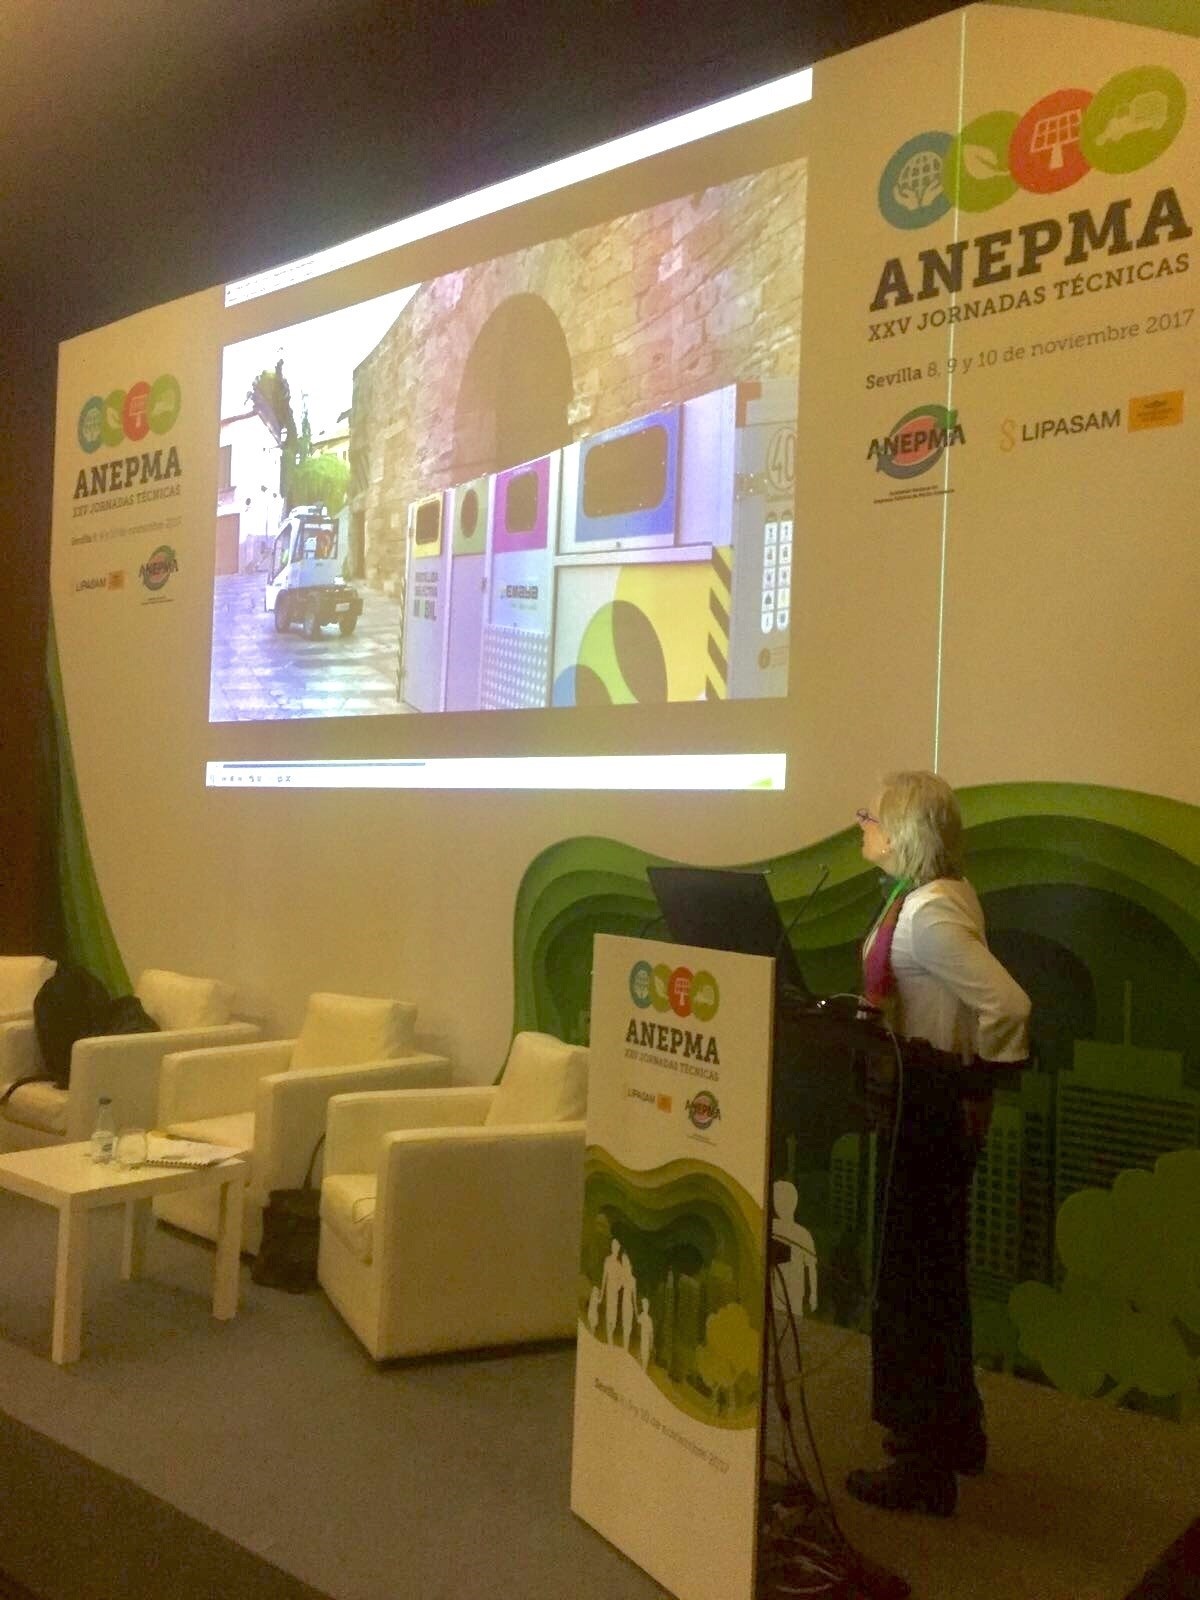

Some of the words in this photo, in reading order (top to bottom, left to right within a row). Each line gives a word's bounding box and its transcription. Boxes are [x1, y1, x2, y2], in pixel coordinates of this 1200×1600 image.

[869, 186, 1193, 312] ANEPMA
[867, 317, 911, 342] XXV
[916, 286, 1046, 332] JORNADAS
[1053, 252, 1190, 300] TÉCNICAS
[865, 367, 922, 390] Sevilla
[946, 358, 957, 374] 9
[962, 357, 973, 374] y
[977, 350, 997, 368] 10
[1003, 345, 1025, 363] de
[1031, 321, 1140, 357] noviembre
[1145, 308, 1195, 334] 2017
[866, 423, 966, 461] ANEPMA
[1022, 409, 1121, 442] LIPASAM
[73, 445, 182, 500] ANEPMA
[625, 1018, 720, 1065] ANEPMA
